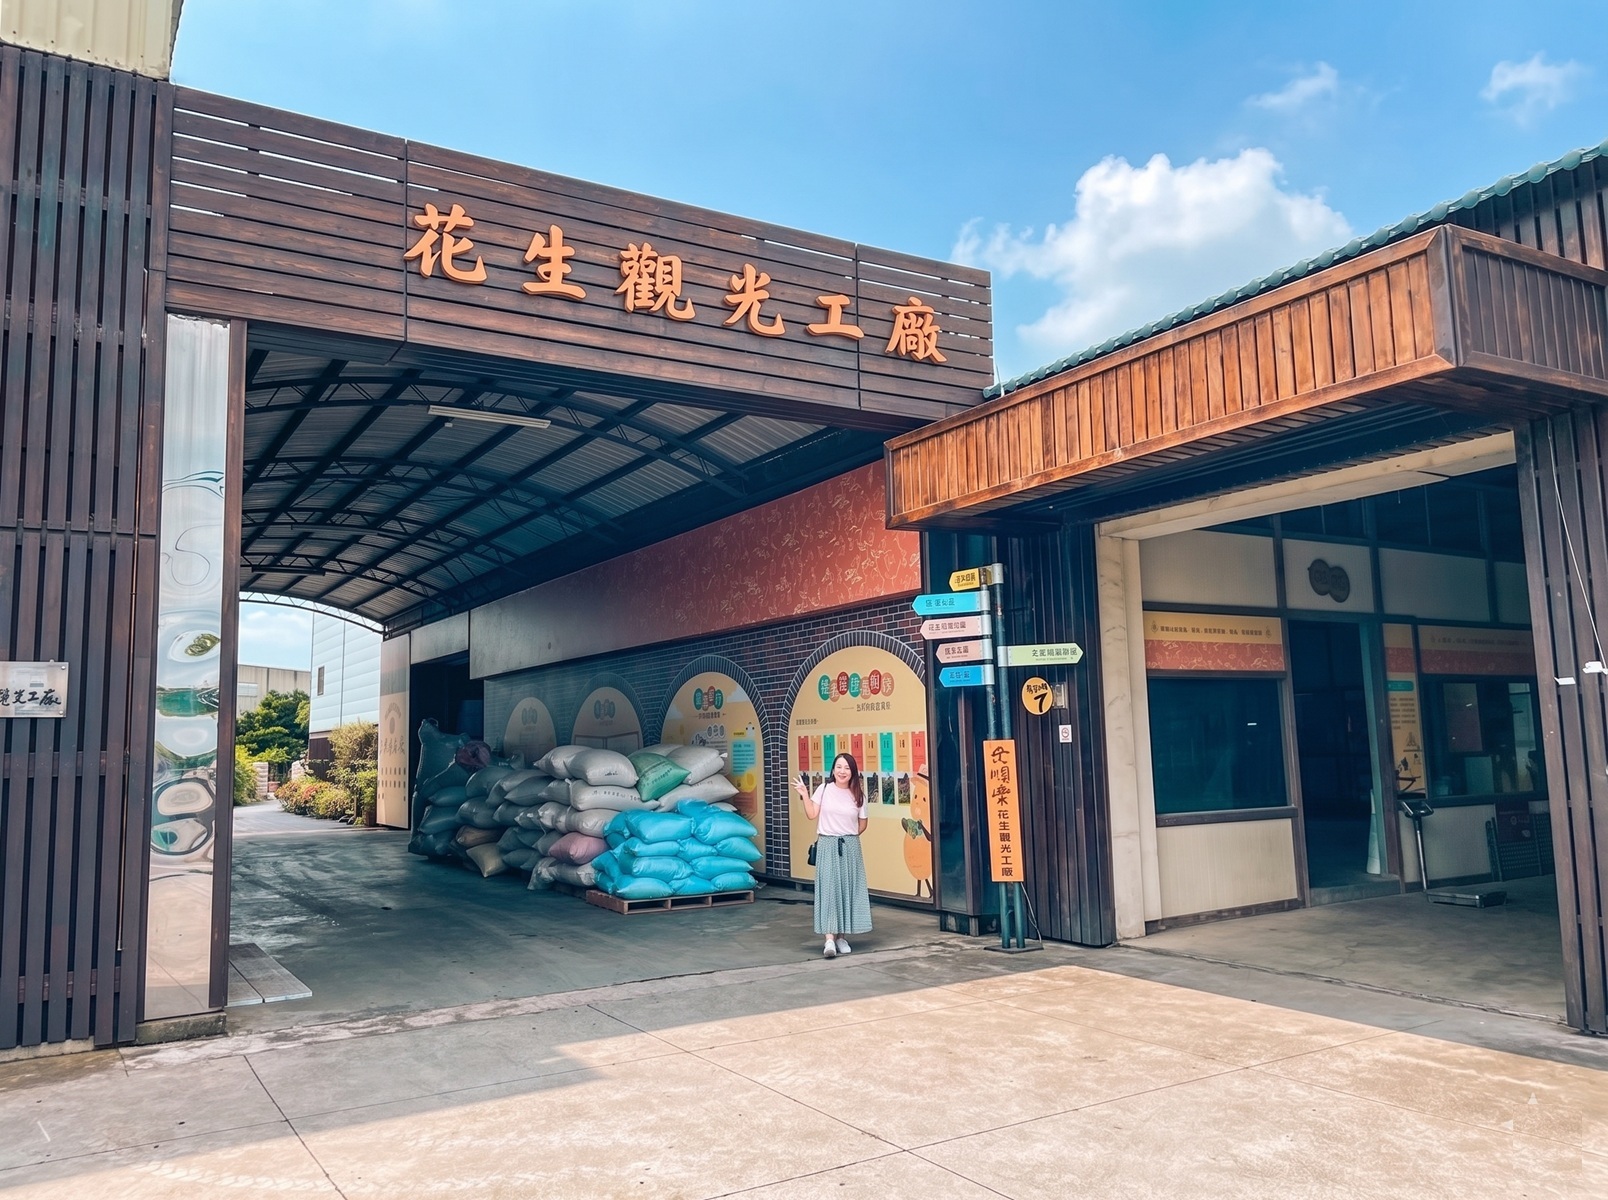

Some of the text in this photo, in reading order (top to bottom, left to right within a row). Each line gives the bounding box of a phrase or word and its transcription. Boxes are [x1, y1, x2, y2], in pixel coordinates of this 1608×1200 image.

[404, 203, 947, 364] 花生觀光工廠
[1033, 691, 1048, 713] 7
